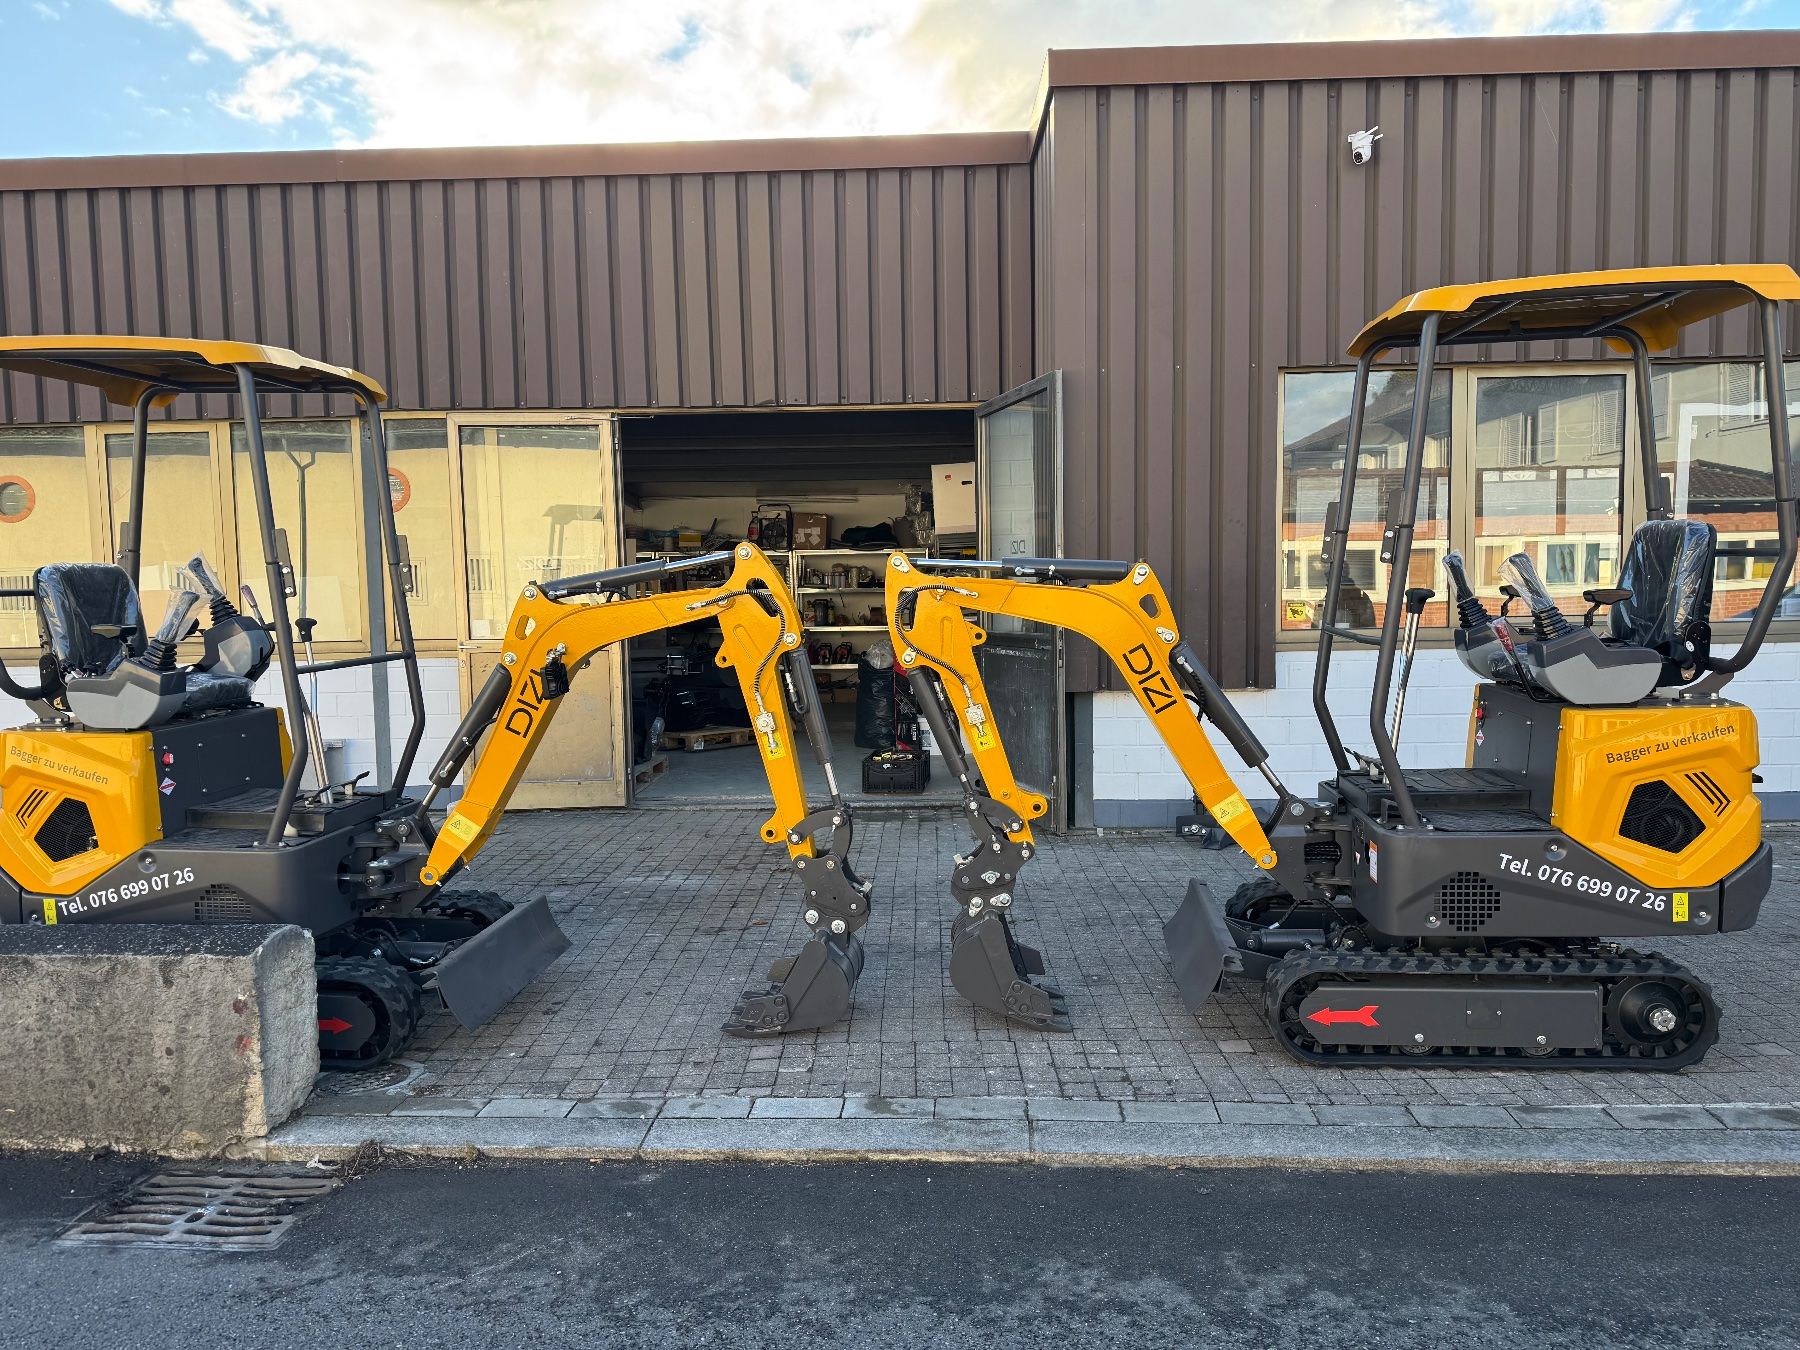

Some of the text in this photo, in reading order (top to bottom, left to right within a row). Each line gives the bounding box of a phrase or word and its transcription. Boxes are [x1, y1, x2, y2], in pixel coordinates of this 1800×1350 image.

[1122, 643, 1178, 714] DIZI
[10, 745, 109, 784] Bagger zu verkaufen
[1605, 724, 1735, 763] Bagger zu verkaufen
[58, 867, 195, 916] Tel. 076 699 07 26
[1500, 853, 1667, 912] Tel. 076 699 07 26
